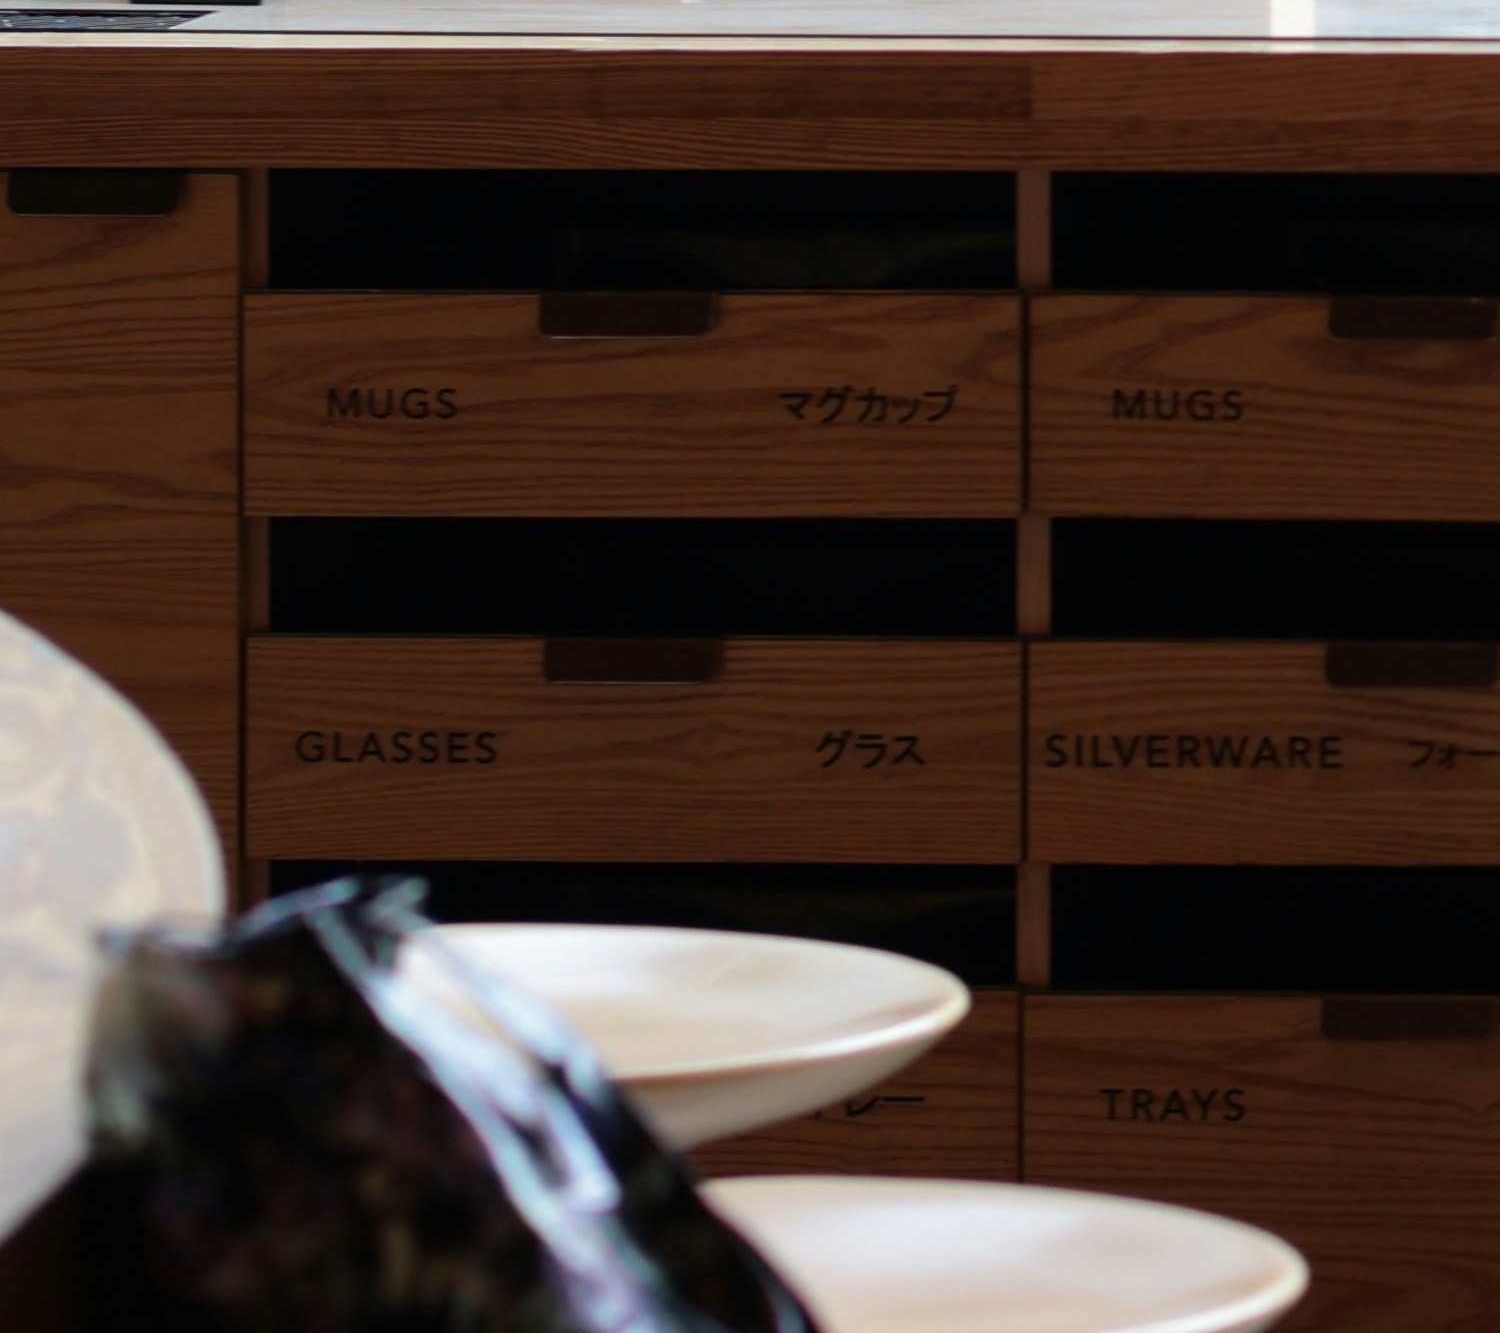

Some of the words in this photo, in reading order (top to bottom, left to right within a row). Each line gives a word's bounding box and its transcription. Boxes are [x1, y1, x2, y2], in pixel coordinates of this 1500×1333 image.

[325, 387, 460, 421] MUGS
[775, 381, 960, 426] マグカップ
[1109, 388, 1245, 422] MUGS
[294, 730, 500, 766] GLASSES
[814, 728, 927, 770] グラス
[1043, 733, 1344, 770] SILVERWARE
[1100, 1087, 1248, 1123] TRAYS
